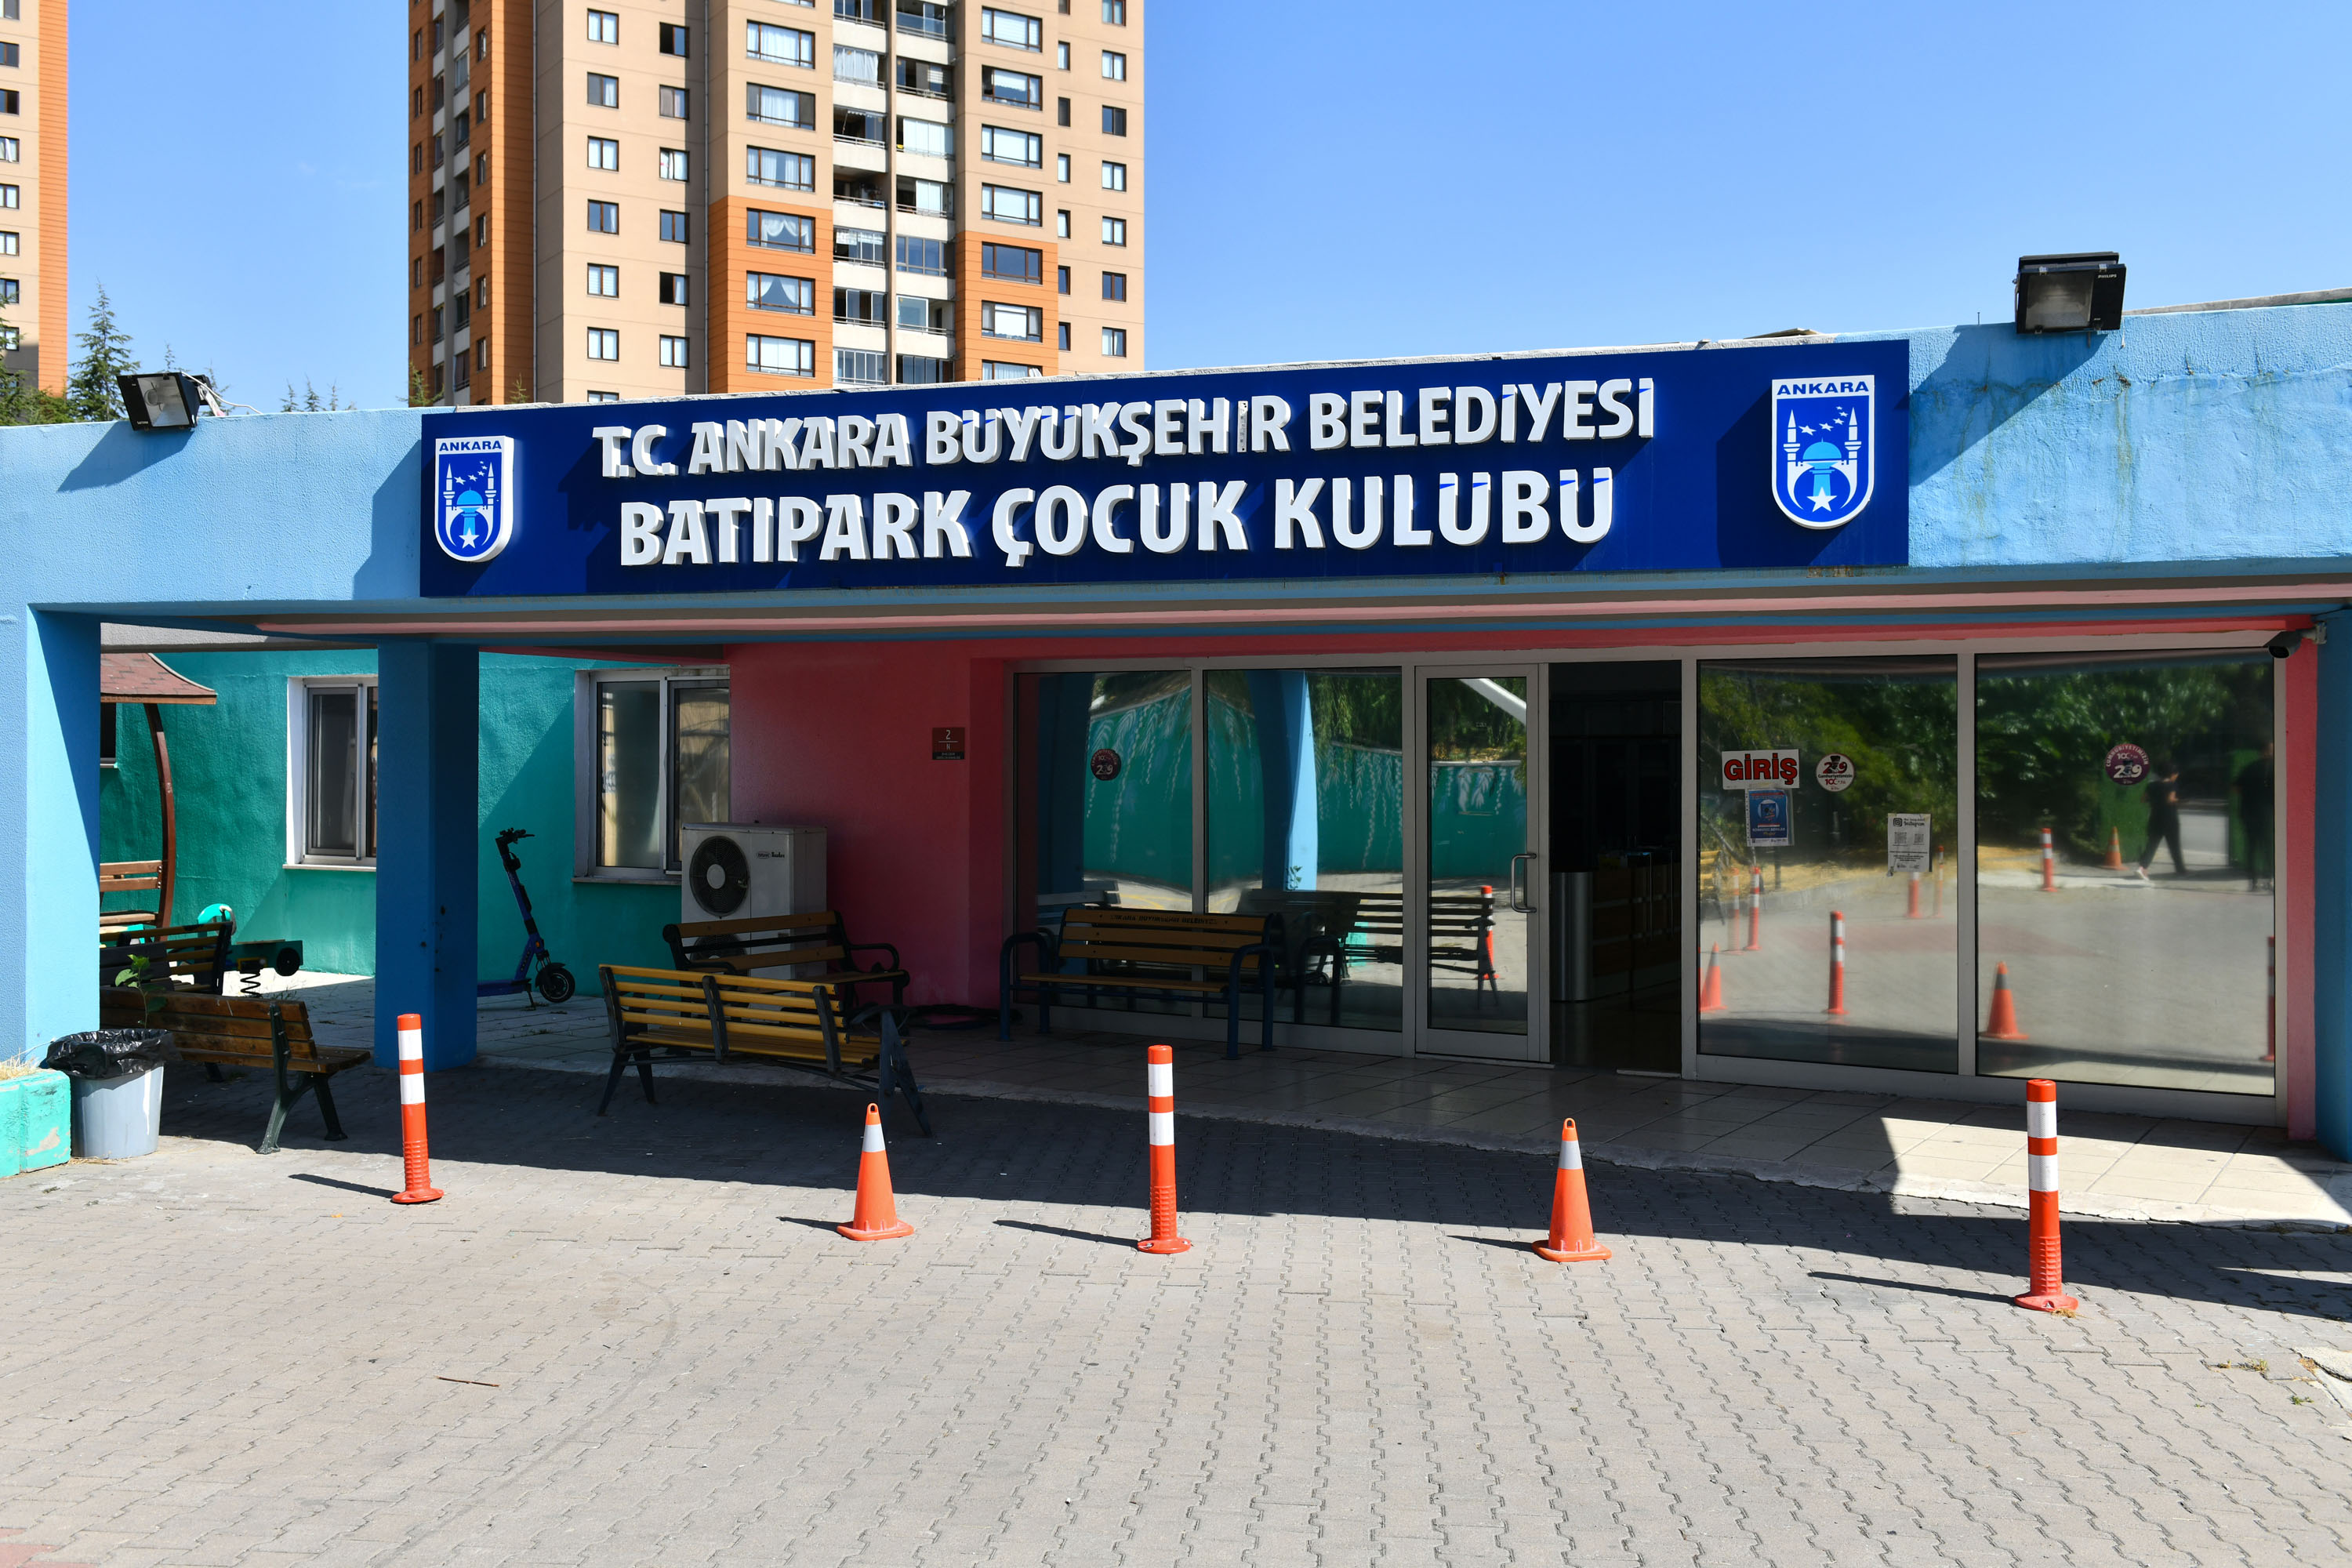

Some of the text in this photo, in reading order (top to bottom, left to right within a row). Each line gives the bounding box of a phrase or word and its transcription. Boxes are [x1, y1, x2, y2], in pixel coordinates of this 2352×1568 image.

[1777, 381, 1869, 396] ANKARA
[593, 425, 677, 477] T.C.
[688, 412, 913, 475] ANKARA
[1309, 377, 1654, 451] BELEDİYESİ
[438, 441, 502, 452] ANKARA
[620, 466, 1613, 568] BATIPARK ÇOCUK KULÜBÜ
[946, 729, 951, 740] 2
[1724, 753, 1798, 785] GİRİŞ
